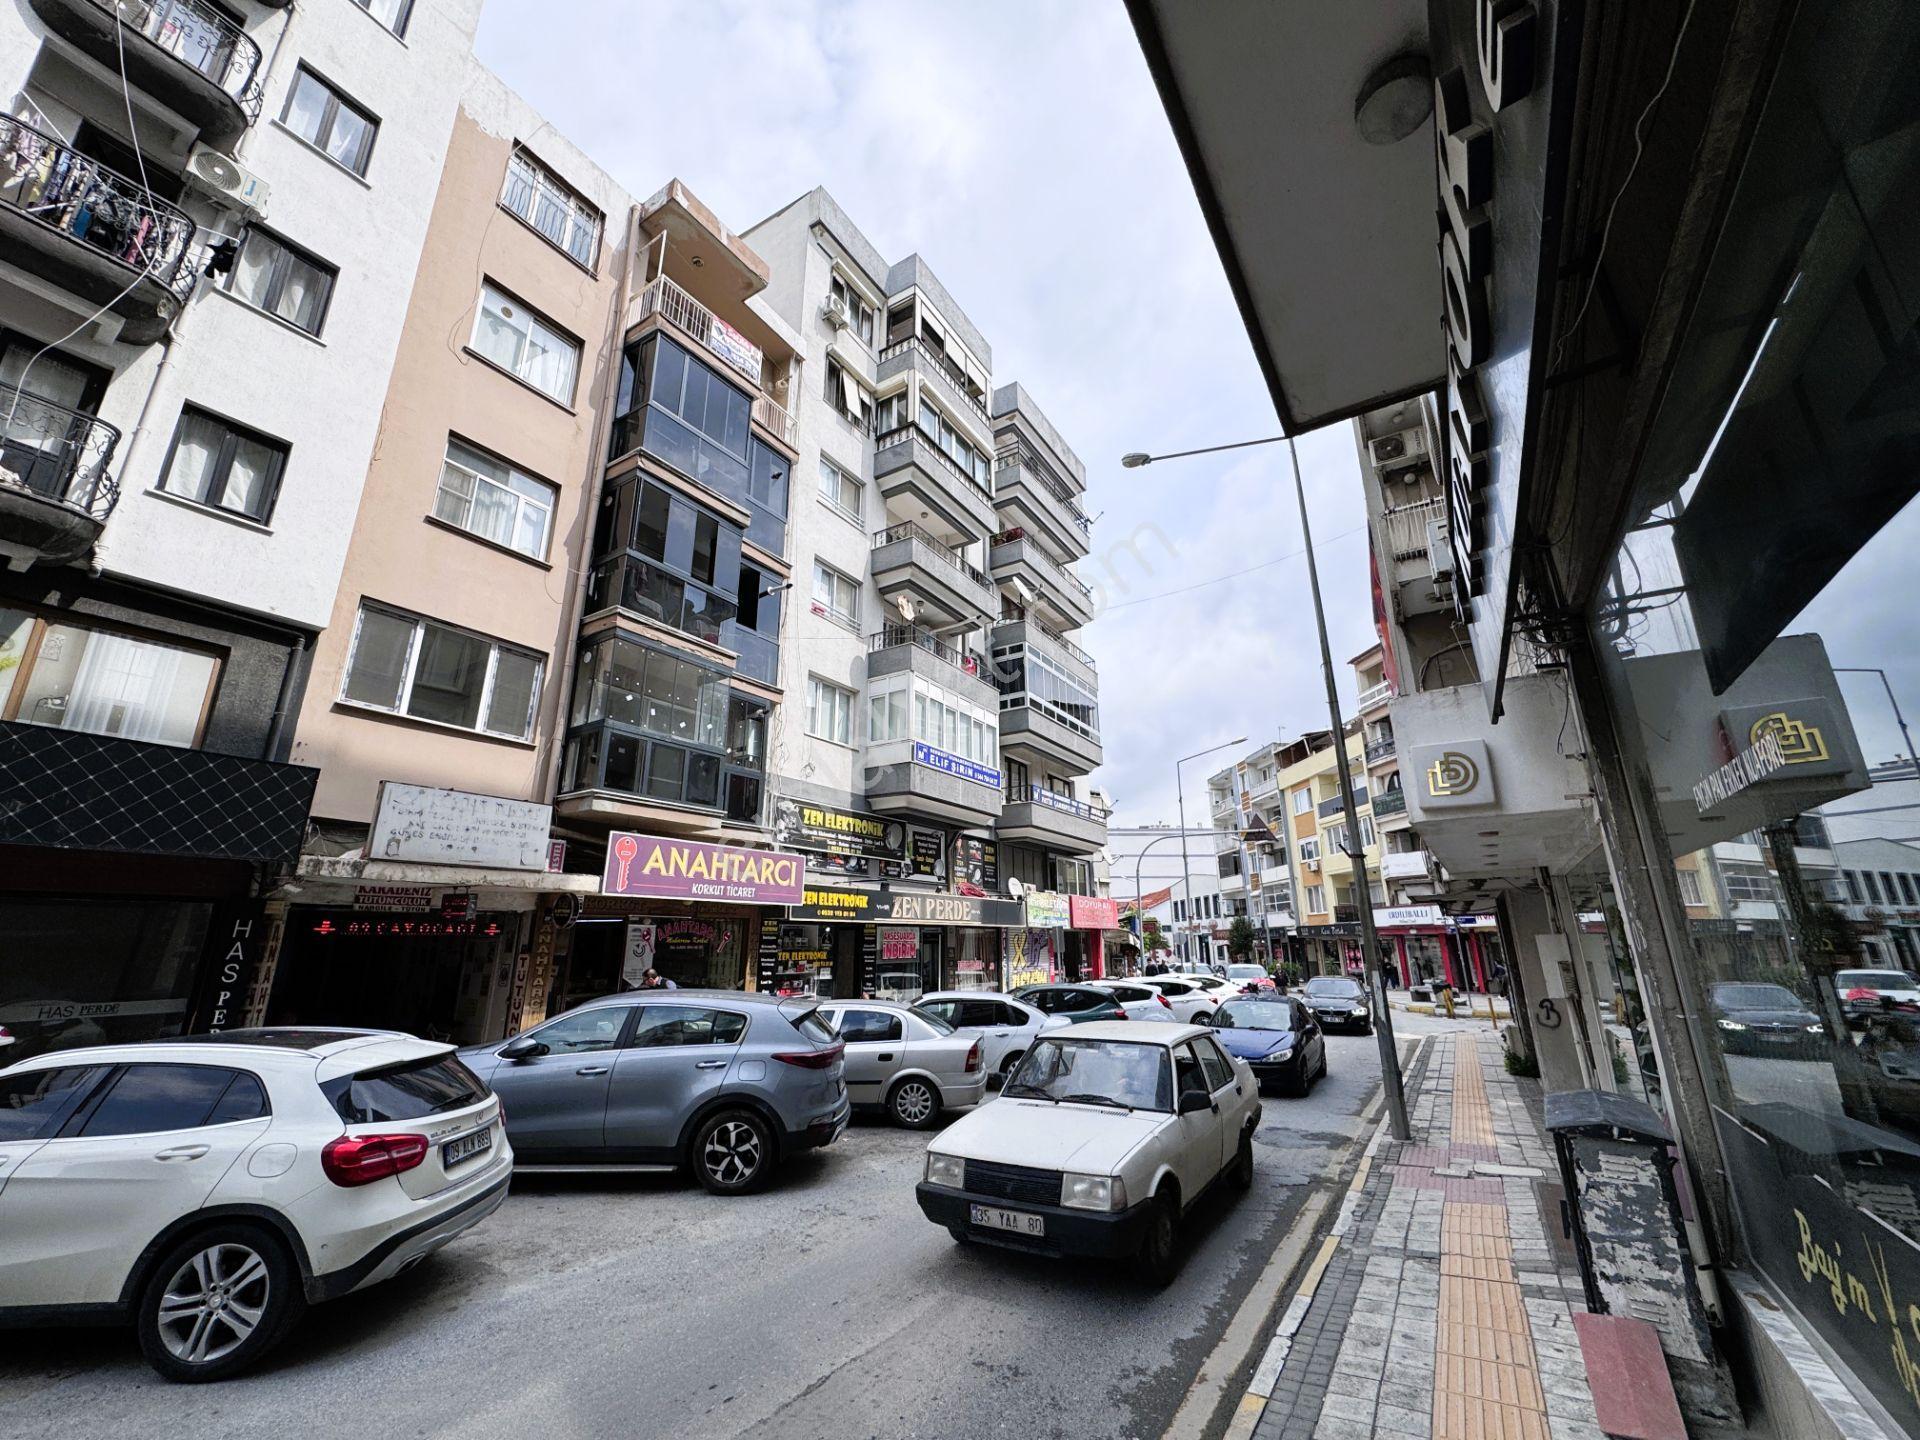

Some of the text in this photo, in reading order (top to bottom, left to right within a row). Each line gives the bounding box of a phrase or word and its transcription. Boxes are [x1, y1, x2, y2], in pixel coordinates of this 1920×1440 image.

[803, 808, 885, 837] ZEN ELEKTRONİK
[641, 844, 798, 888] ANAHTARCI
[692, 882, 756, 898] KORKUT TİCARET
[803, 890, 818, 906] ZEN
[892, 896, 972, 920] ZEN PERDE
[38, 1005, 76, 1019] HAS
